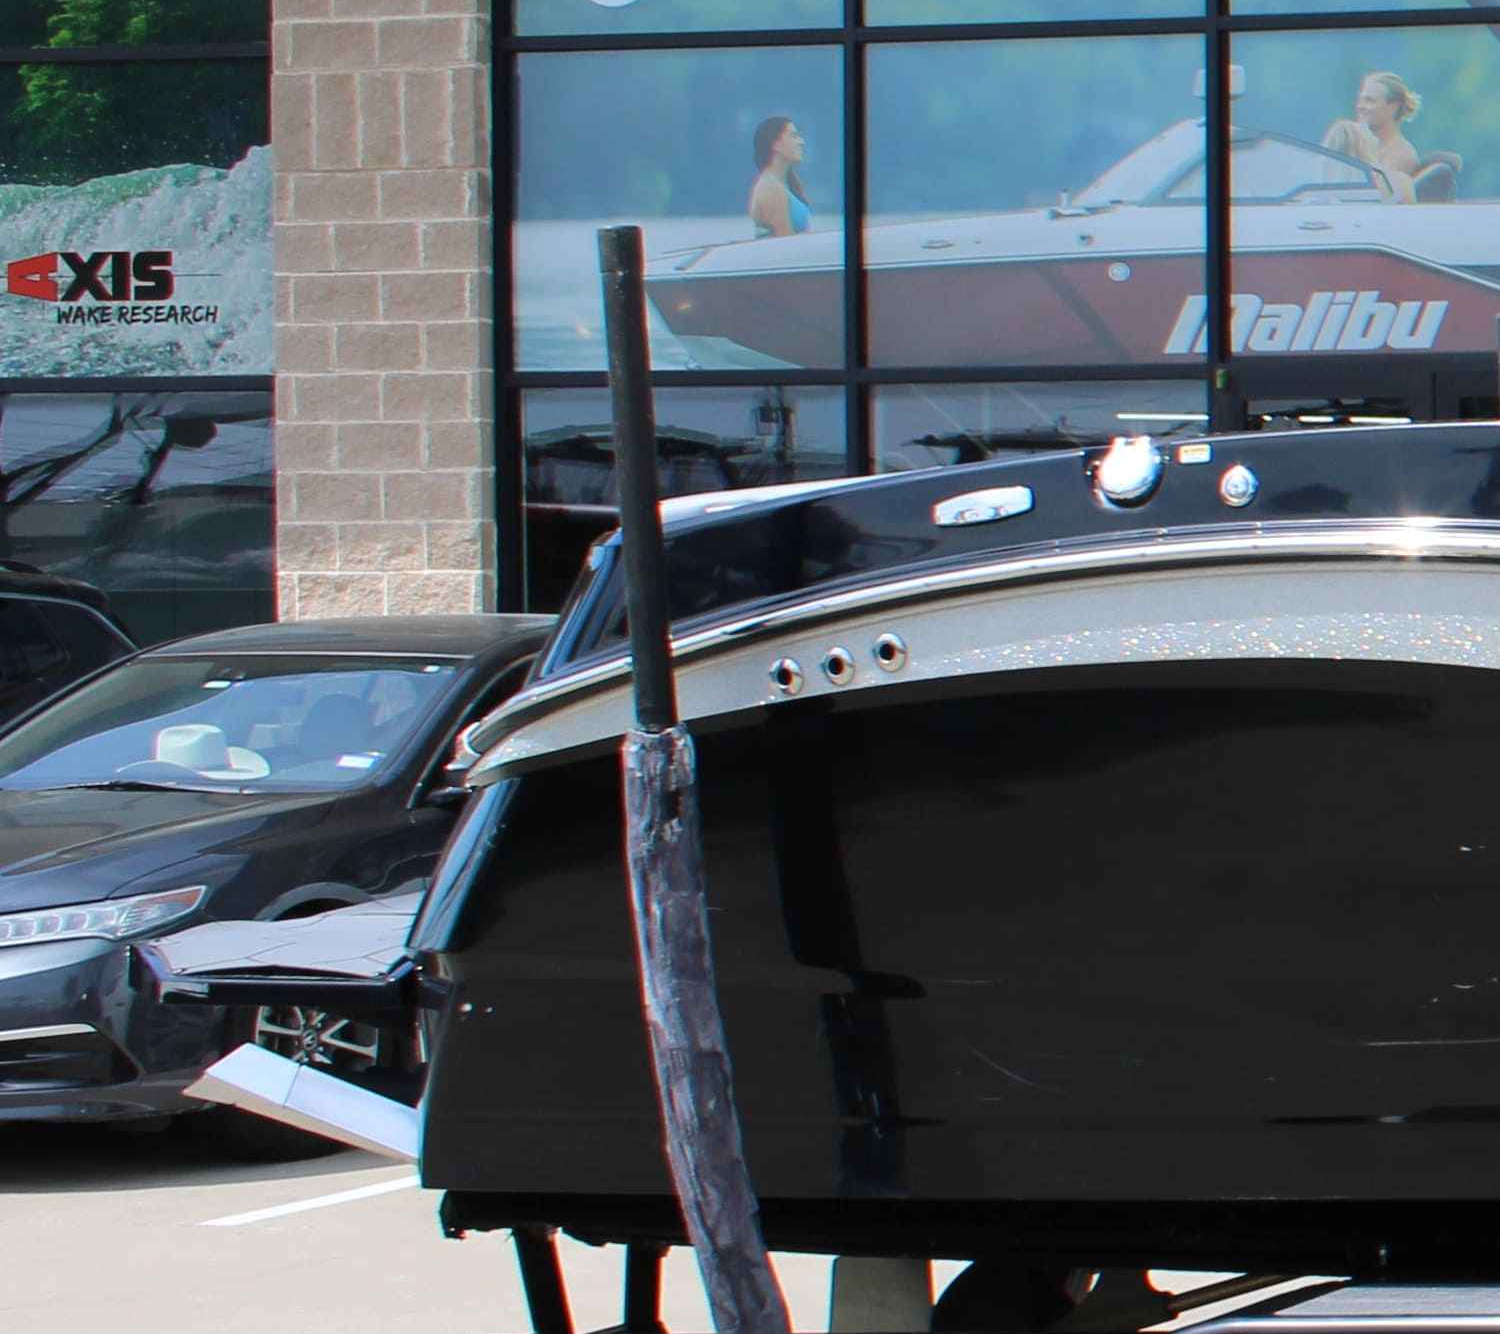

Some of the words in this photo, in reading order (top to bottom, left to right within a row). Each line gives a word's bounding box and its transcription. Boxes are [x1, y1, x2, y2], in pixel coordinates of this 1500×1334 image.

[7, 250, 176, 302] AXIS
[57, 305, 113, 325] WAKE
[117, 304, 219, 326] RESEARCH
[1162, 290, 1449, 354] Malibu
